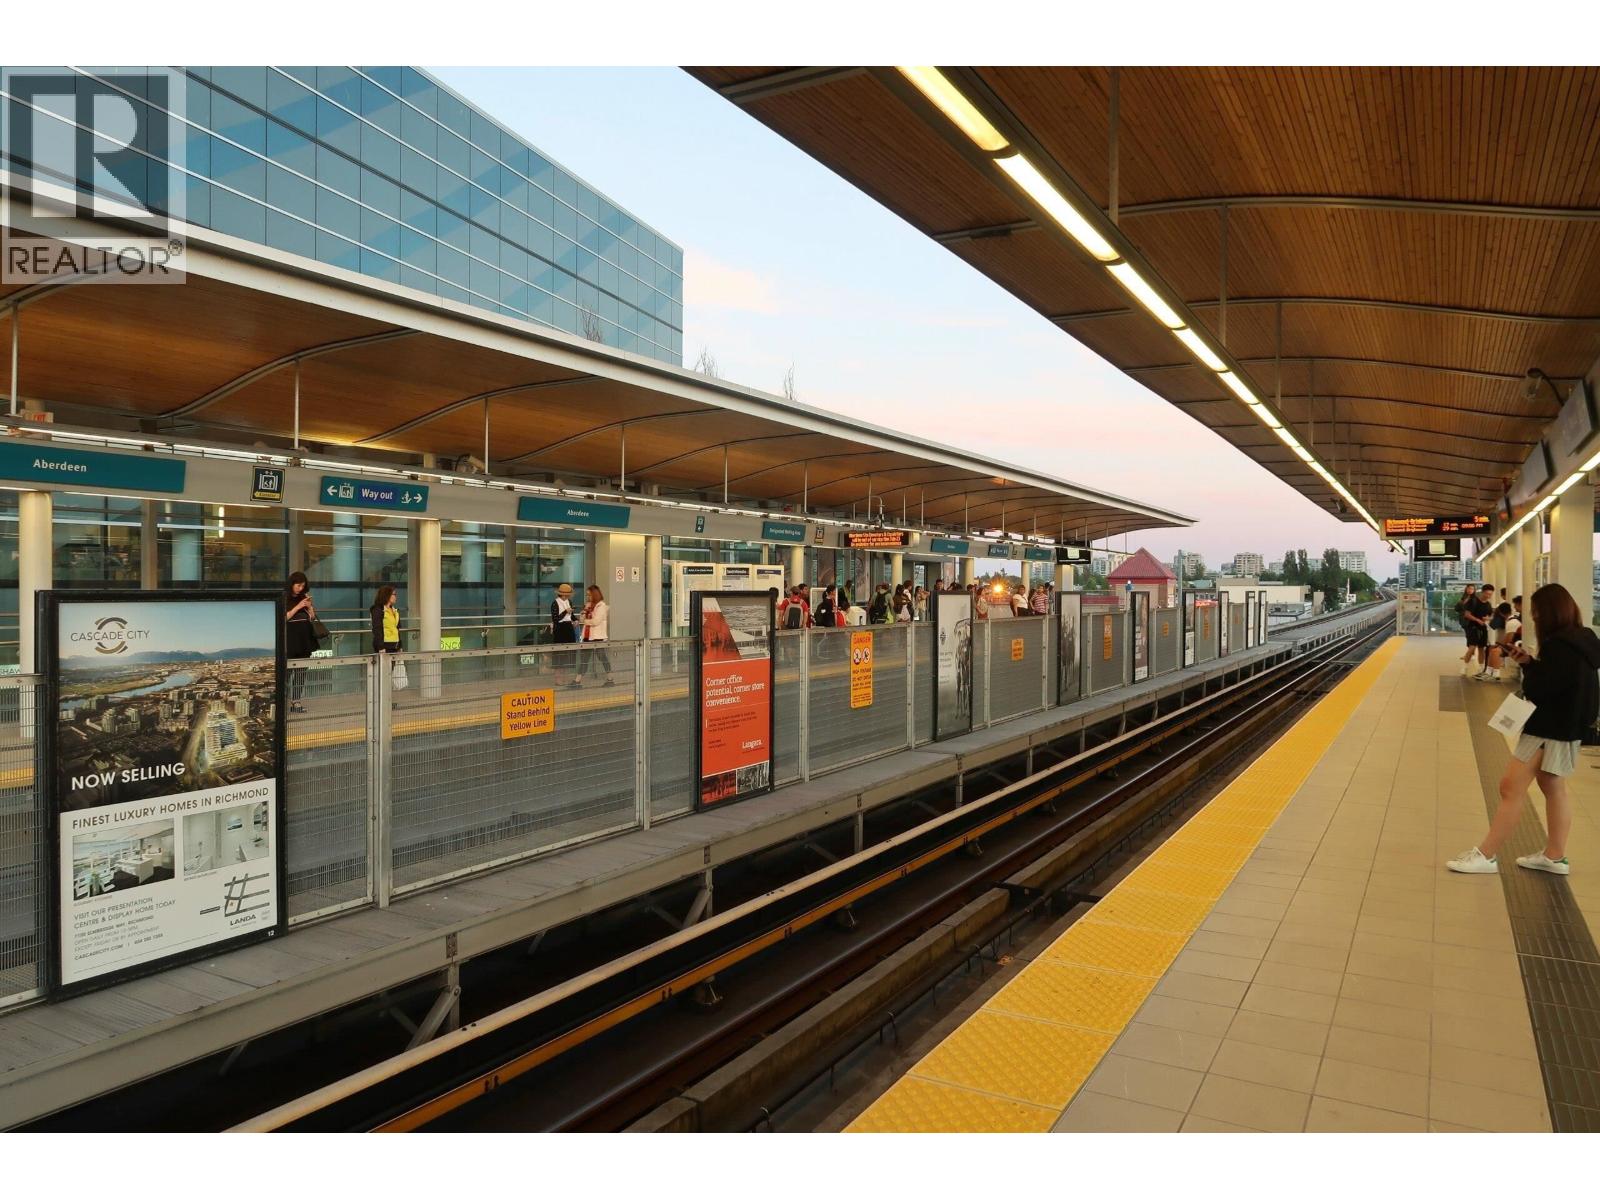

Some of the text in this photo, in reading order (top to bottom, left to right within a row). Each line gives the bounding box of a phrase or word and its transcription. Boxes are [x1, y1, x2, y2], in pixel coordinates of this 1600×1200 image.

[33, 459, 87, 472] Aberdeen
[361, 488, 393, 500] Way out
[566, 509, 589, 517] Aberdeen
[70, 630, 150, 641] CASCADE CITY
[706, 674, 743, 686] Corner office
[733, 684, 751, 693] corner
[752, 682, 765, 691] store
[511, 695, 546, 707] CAUTION
[706, 695, 741, 707] convenience.
[506, 706, 550, 720] Stand Behind
[510, 719, 547, 731] Yellow Line
[71, 762, 186, 791] NOW SELLING
[73, 787, 269, 830] FINEST LUXURY HOMES IN RICHMOND
[74, 911, 90, 921] VISIT
[91, 907, 106, 917] OUR
[108, 897, 153, 913] PRESENTATION
[74, 918, 99, 929] CENTRE
[108, 911, 133, 921] DISPLAY
[135, 905, 154, 914] HOME
[156, 899, 176, 909] TODAY
[230, 914, 256, 926] LANDA
